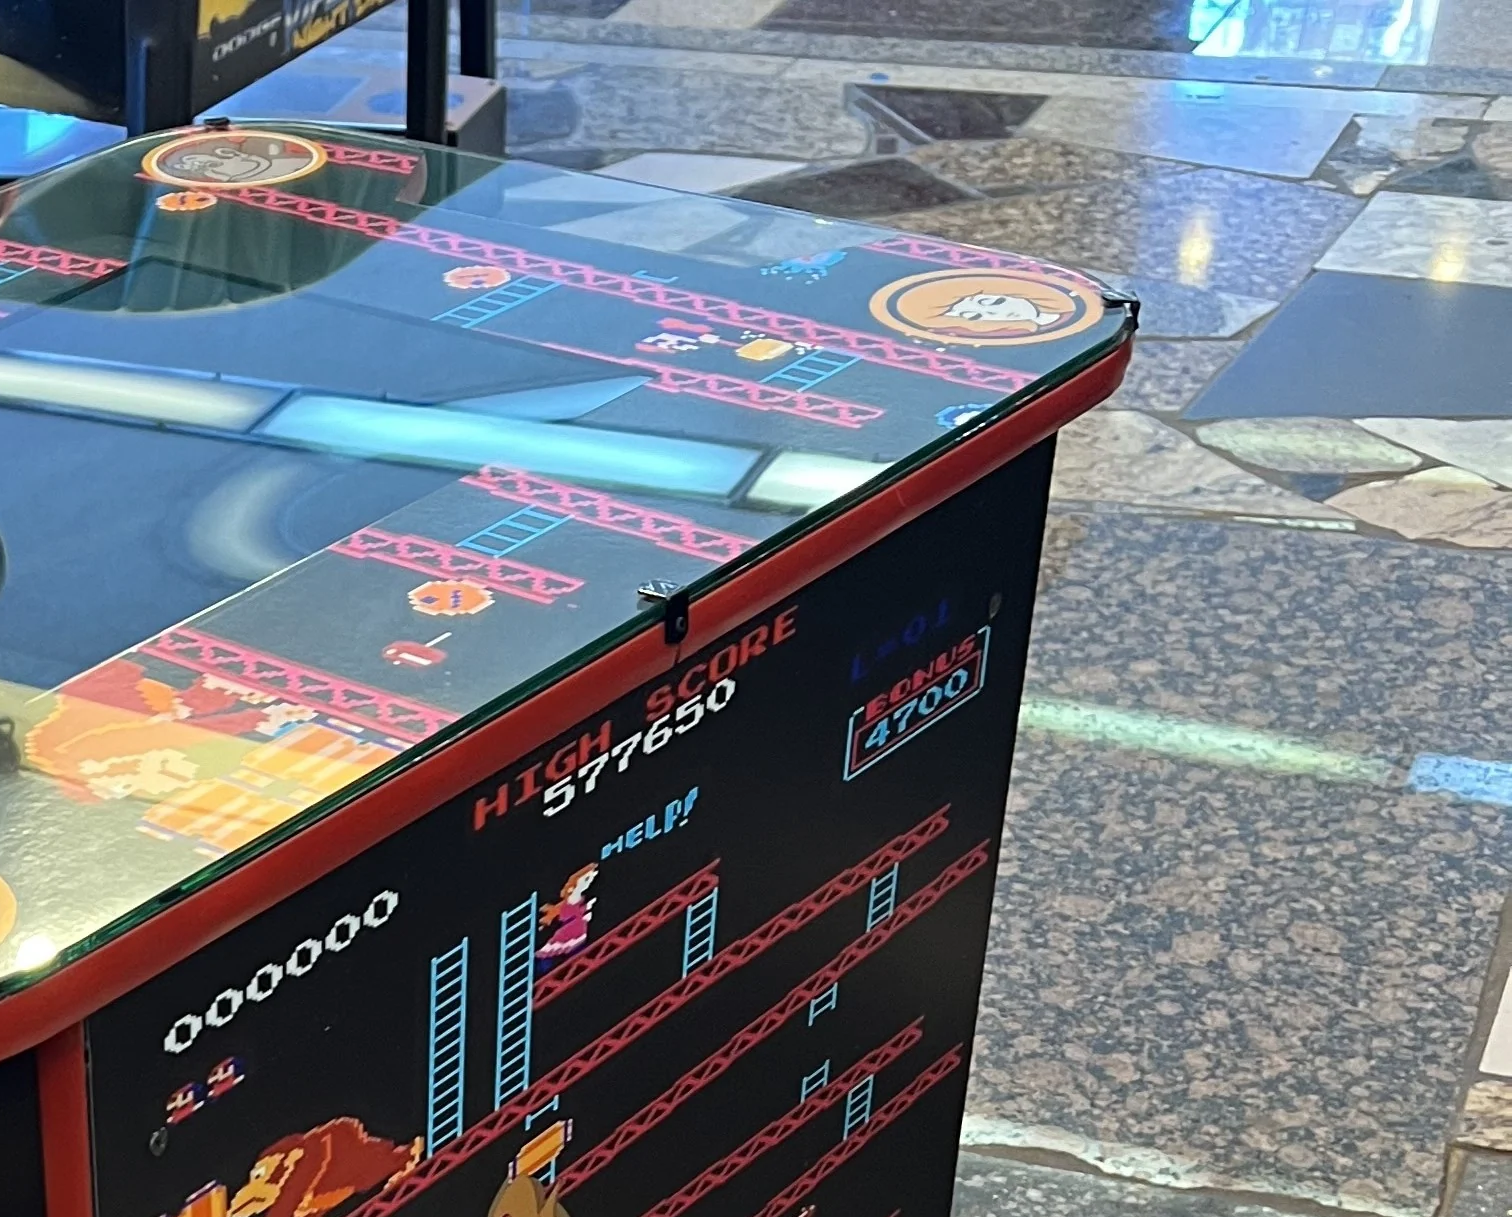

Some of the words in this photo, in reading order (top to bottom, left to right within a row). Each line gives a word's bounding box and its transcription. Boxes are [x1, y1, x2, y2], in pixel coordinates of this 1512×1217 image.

[473, 719, 613, 831] HIGH
[645, 604, 800, 723] SCORE
[864, 633, 977, 722] BONUS
[864, 668, 969, 750] 4700
[542, 677, 737, 817] 577650
[600, 786, 699, 861] HELP!
[163, 889, 399, 1054] 000000
